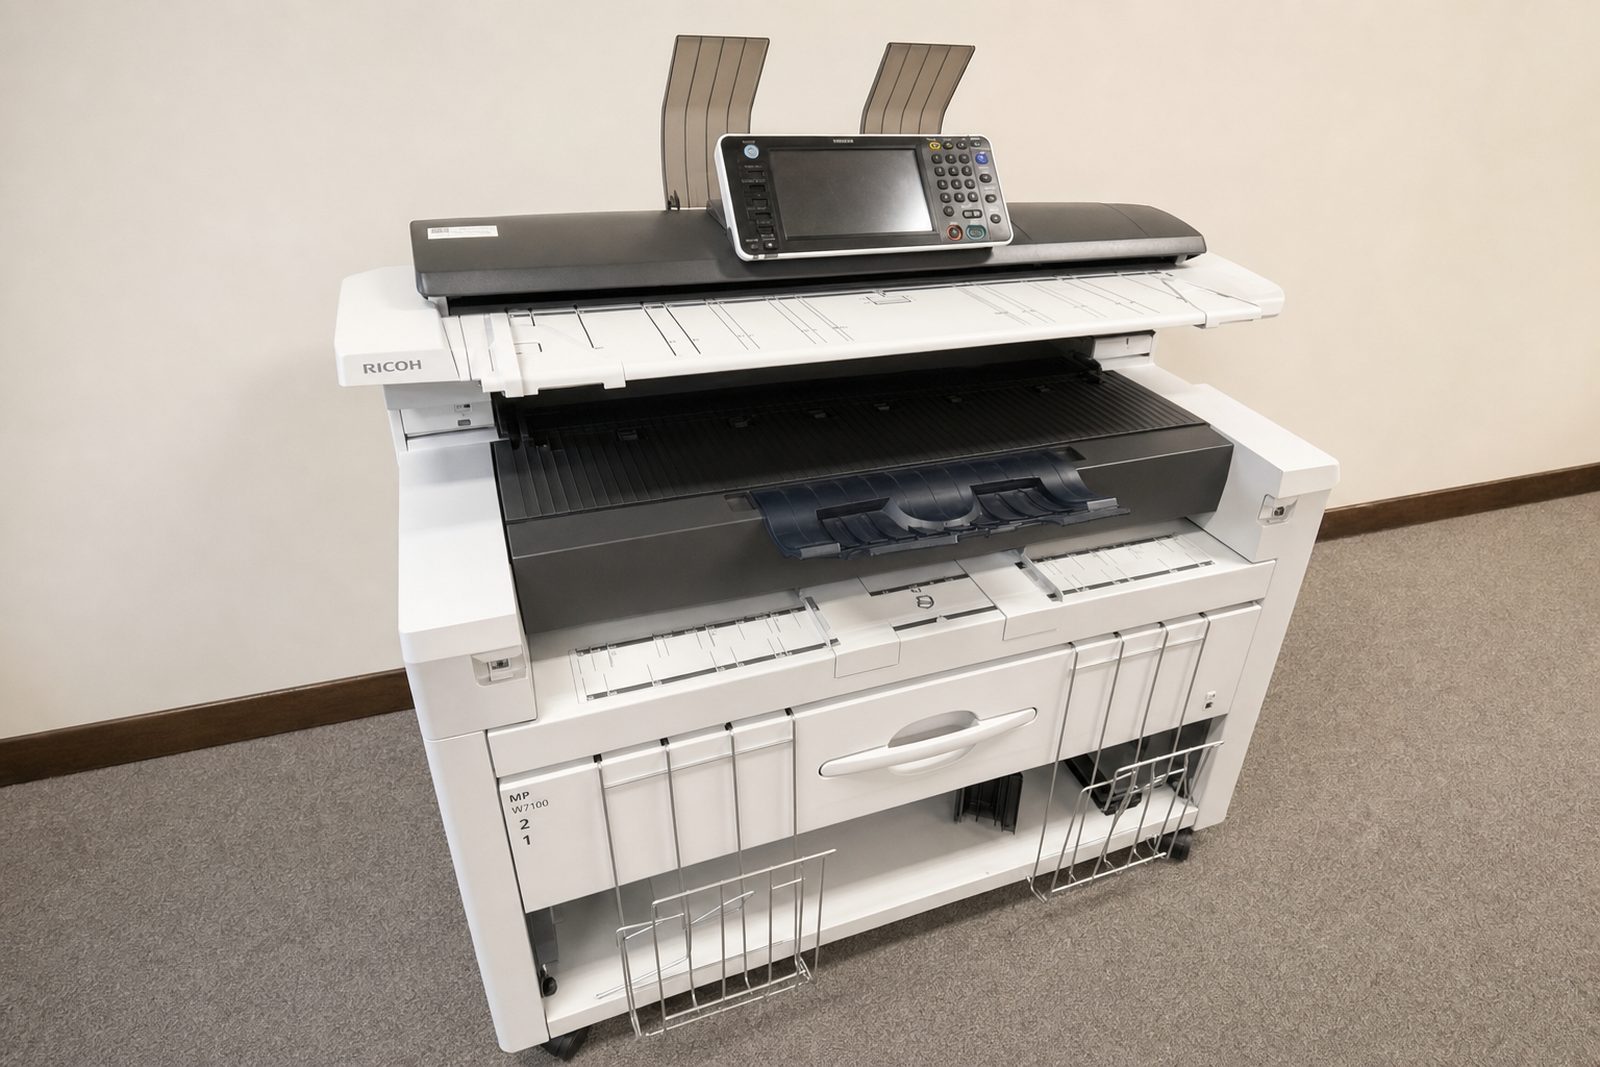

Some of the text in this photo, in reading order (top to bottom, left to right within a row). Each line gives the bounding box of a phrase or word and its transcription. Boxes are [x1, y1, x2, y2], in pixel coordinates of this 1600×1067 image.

[363, 360, 422, 374] RICOH
[509, 791, 530, 803] MP
[512, 800, 549, 814] W7100
[520, 819, 530, 830] 2
[523, 835, 530, 845] 1
